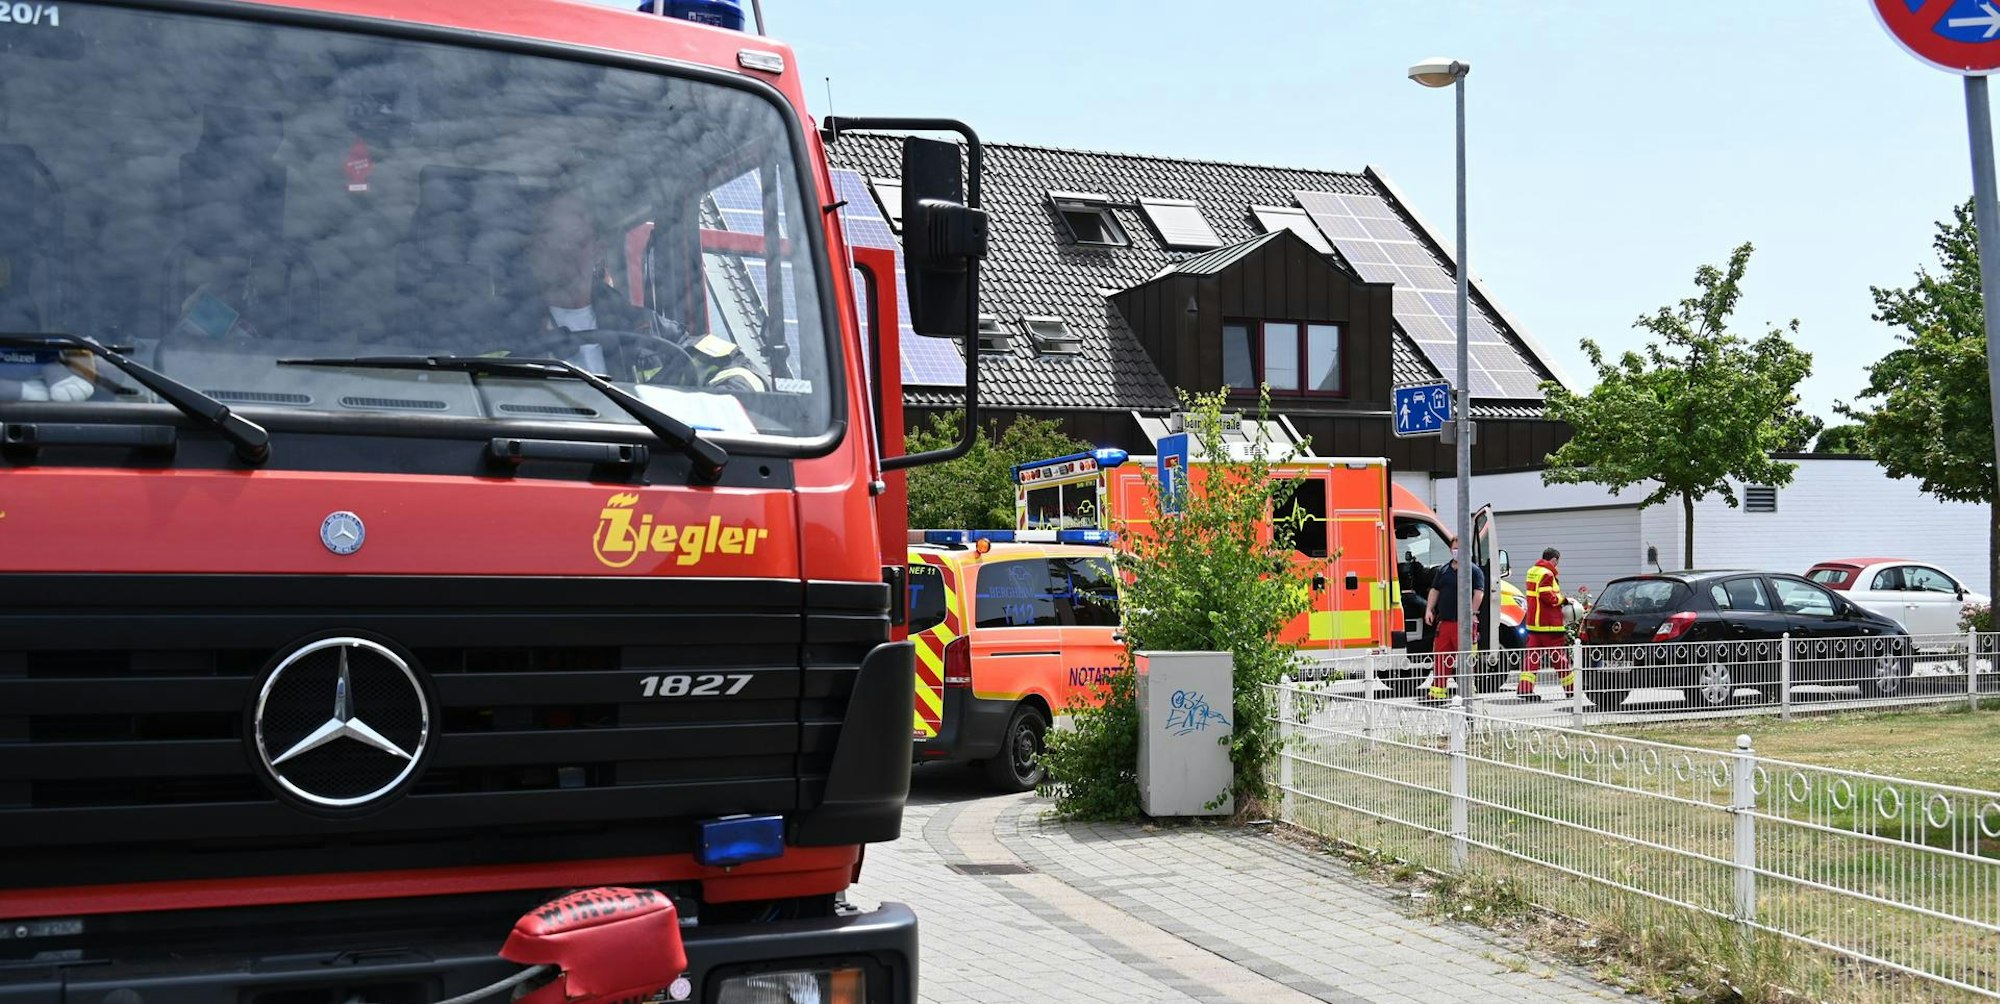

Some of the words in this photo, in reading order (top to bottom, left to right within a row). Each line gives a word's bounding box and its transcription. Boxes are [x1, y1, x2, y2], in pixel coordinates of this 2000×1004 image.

[597, 506, 768, 566] Ziegler
[908, 566, 925, 575] NEF
[640, 674, 754, 697] 1827
[1068, 666, 1125, 687] NOTAR
